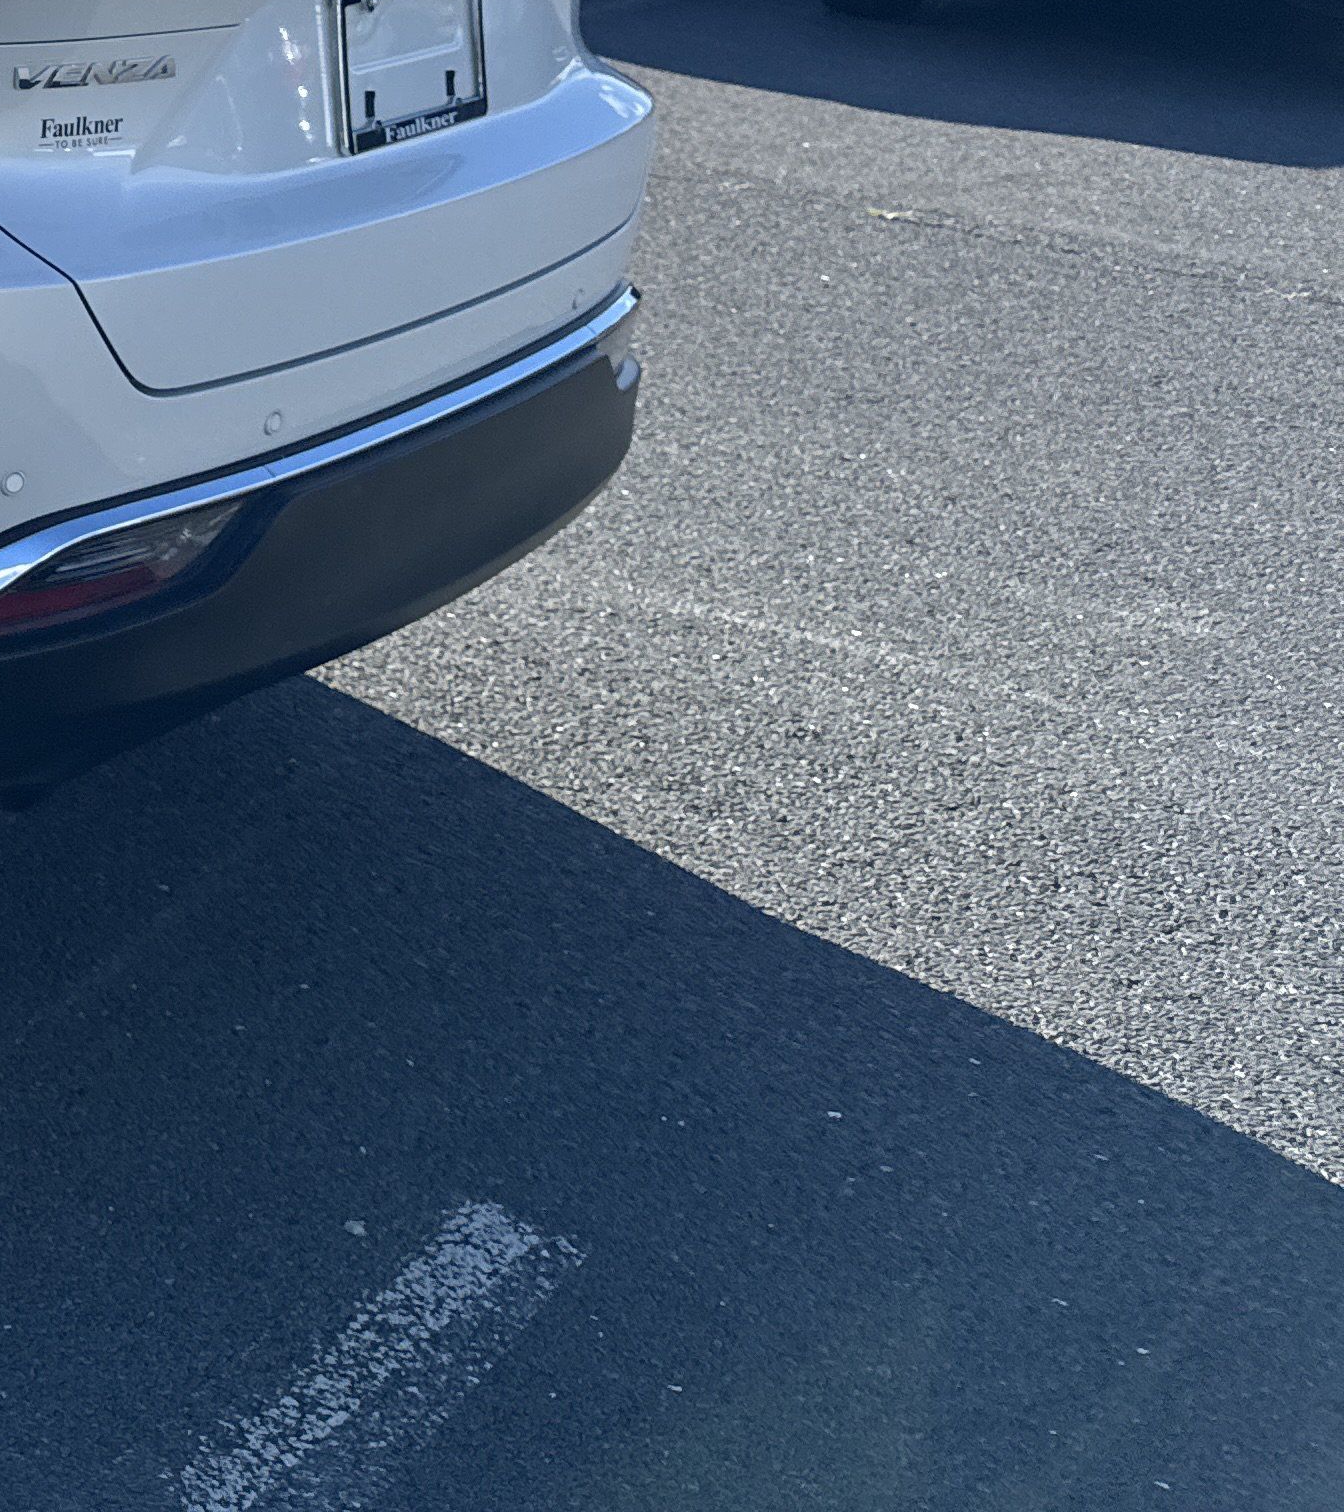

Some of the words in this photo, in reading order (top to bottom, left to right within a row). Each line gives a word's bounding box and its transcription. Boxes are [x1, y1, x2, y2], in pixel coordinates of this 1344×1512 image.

[14, 54, 177, 90] VENZA
[40, 116, 124, 139] Faulkner
[385, 111, 459, 144] Faulkner
[55, 139, 69, 149] TO
[72, 138, 83, 148] BE
[86, 135, 109, 147] SURE
